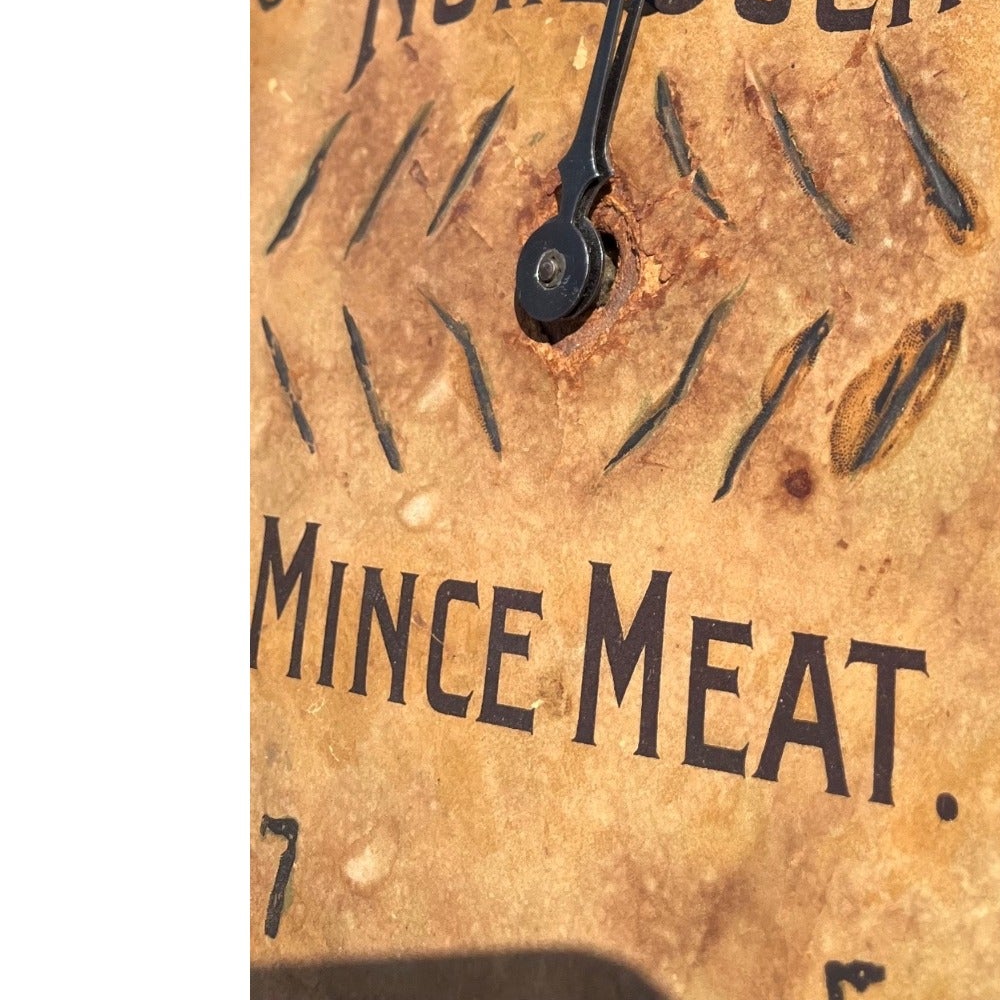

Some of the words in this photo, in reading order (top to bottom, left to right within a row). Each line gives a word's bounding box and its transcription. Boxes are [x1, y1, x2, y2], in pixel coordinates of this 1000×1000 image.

[250, 515, 544, 735] MINCE
[571, 560, 959, 822] MEAT.
[260, 814, 299, 939] 7
